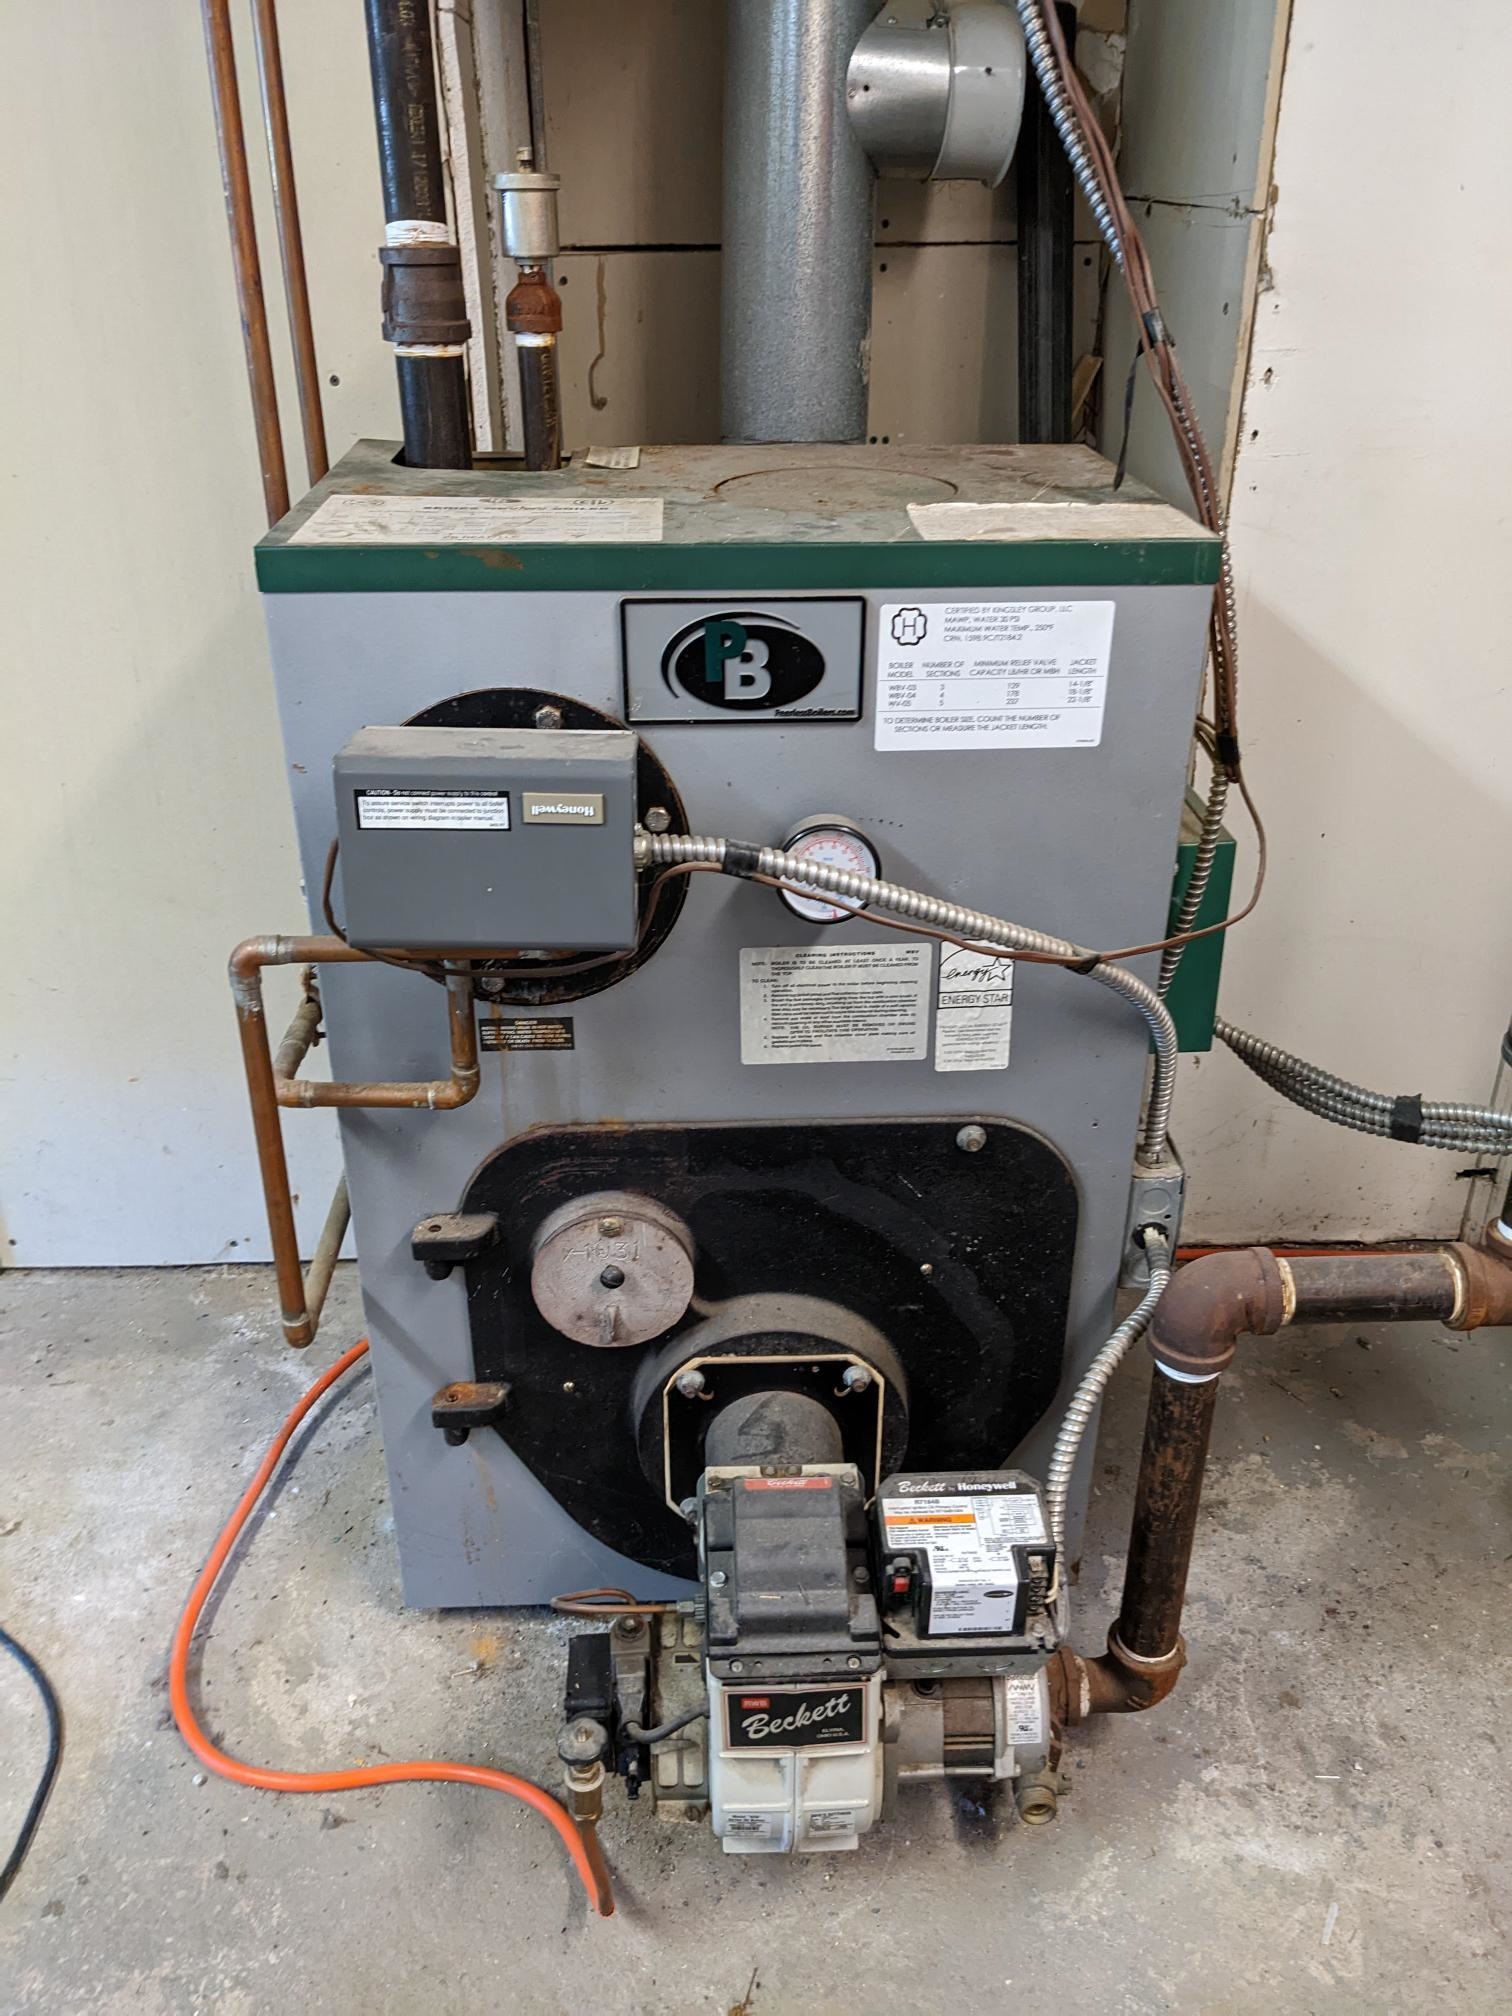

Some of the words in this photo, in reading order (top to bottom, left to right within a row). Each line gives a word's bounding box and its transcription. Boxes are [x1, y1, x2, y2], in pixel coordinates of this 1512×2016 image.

[944, 606, 980, 614] CERTIFIED
[705, 620, 772, 700] PB
[888, 661, 914, 669] BOILER
[1070, 658, 1097, 666] JACKET
[887, 670, 914, 678] MODEL
[531, 804, 595, 816] Honeywell
[941, 994, 980, 1004] ENERGY
[983, 993, 1009, 1004] STAR
[898, 1481, 946, 1493] Beckett
[957, 1481, 1017, 1492] Honeywell
[742, 1693, 852, 1739] Beckett
